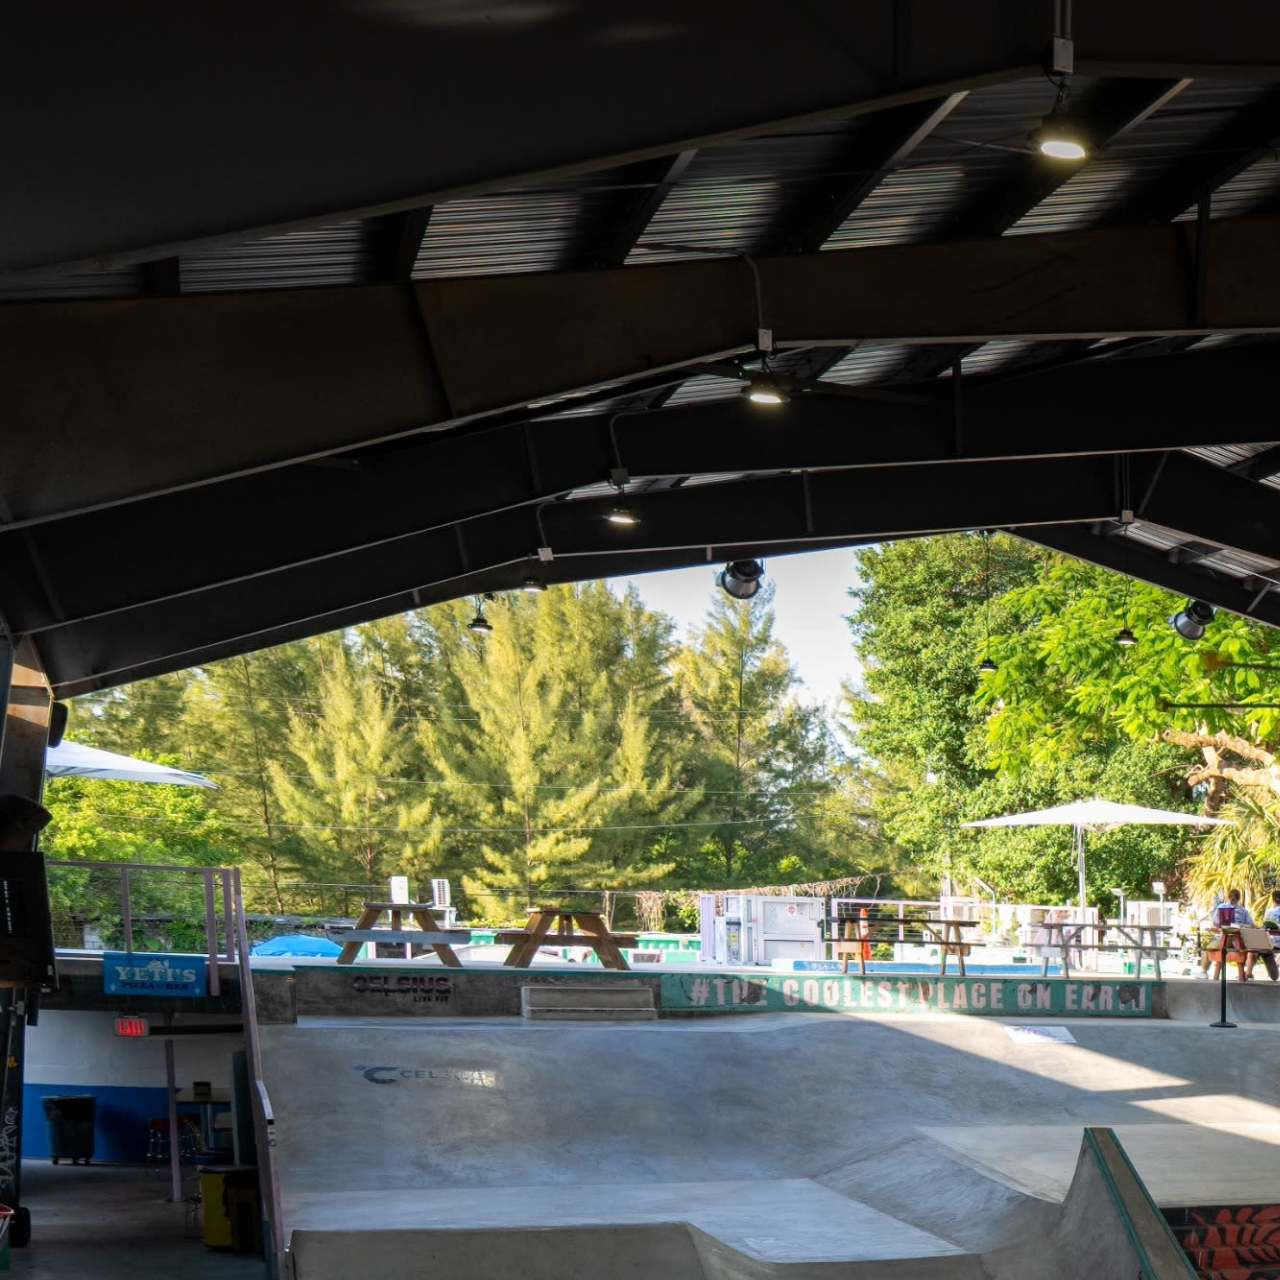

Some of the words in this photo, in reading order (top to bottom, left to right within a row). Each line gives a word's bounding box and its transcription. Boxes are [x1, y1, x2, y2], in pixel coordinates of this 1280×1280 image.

[114, 966, 197, 983] YETI'S
[352, 975, 452, 995] CELSIUS
[782, 978, 911, 1009] COOLEST
[1017, 982, 1052, 1010] ON
